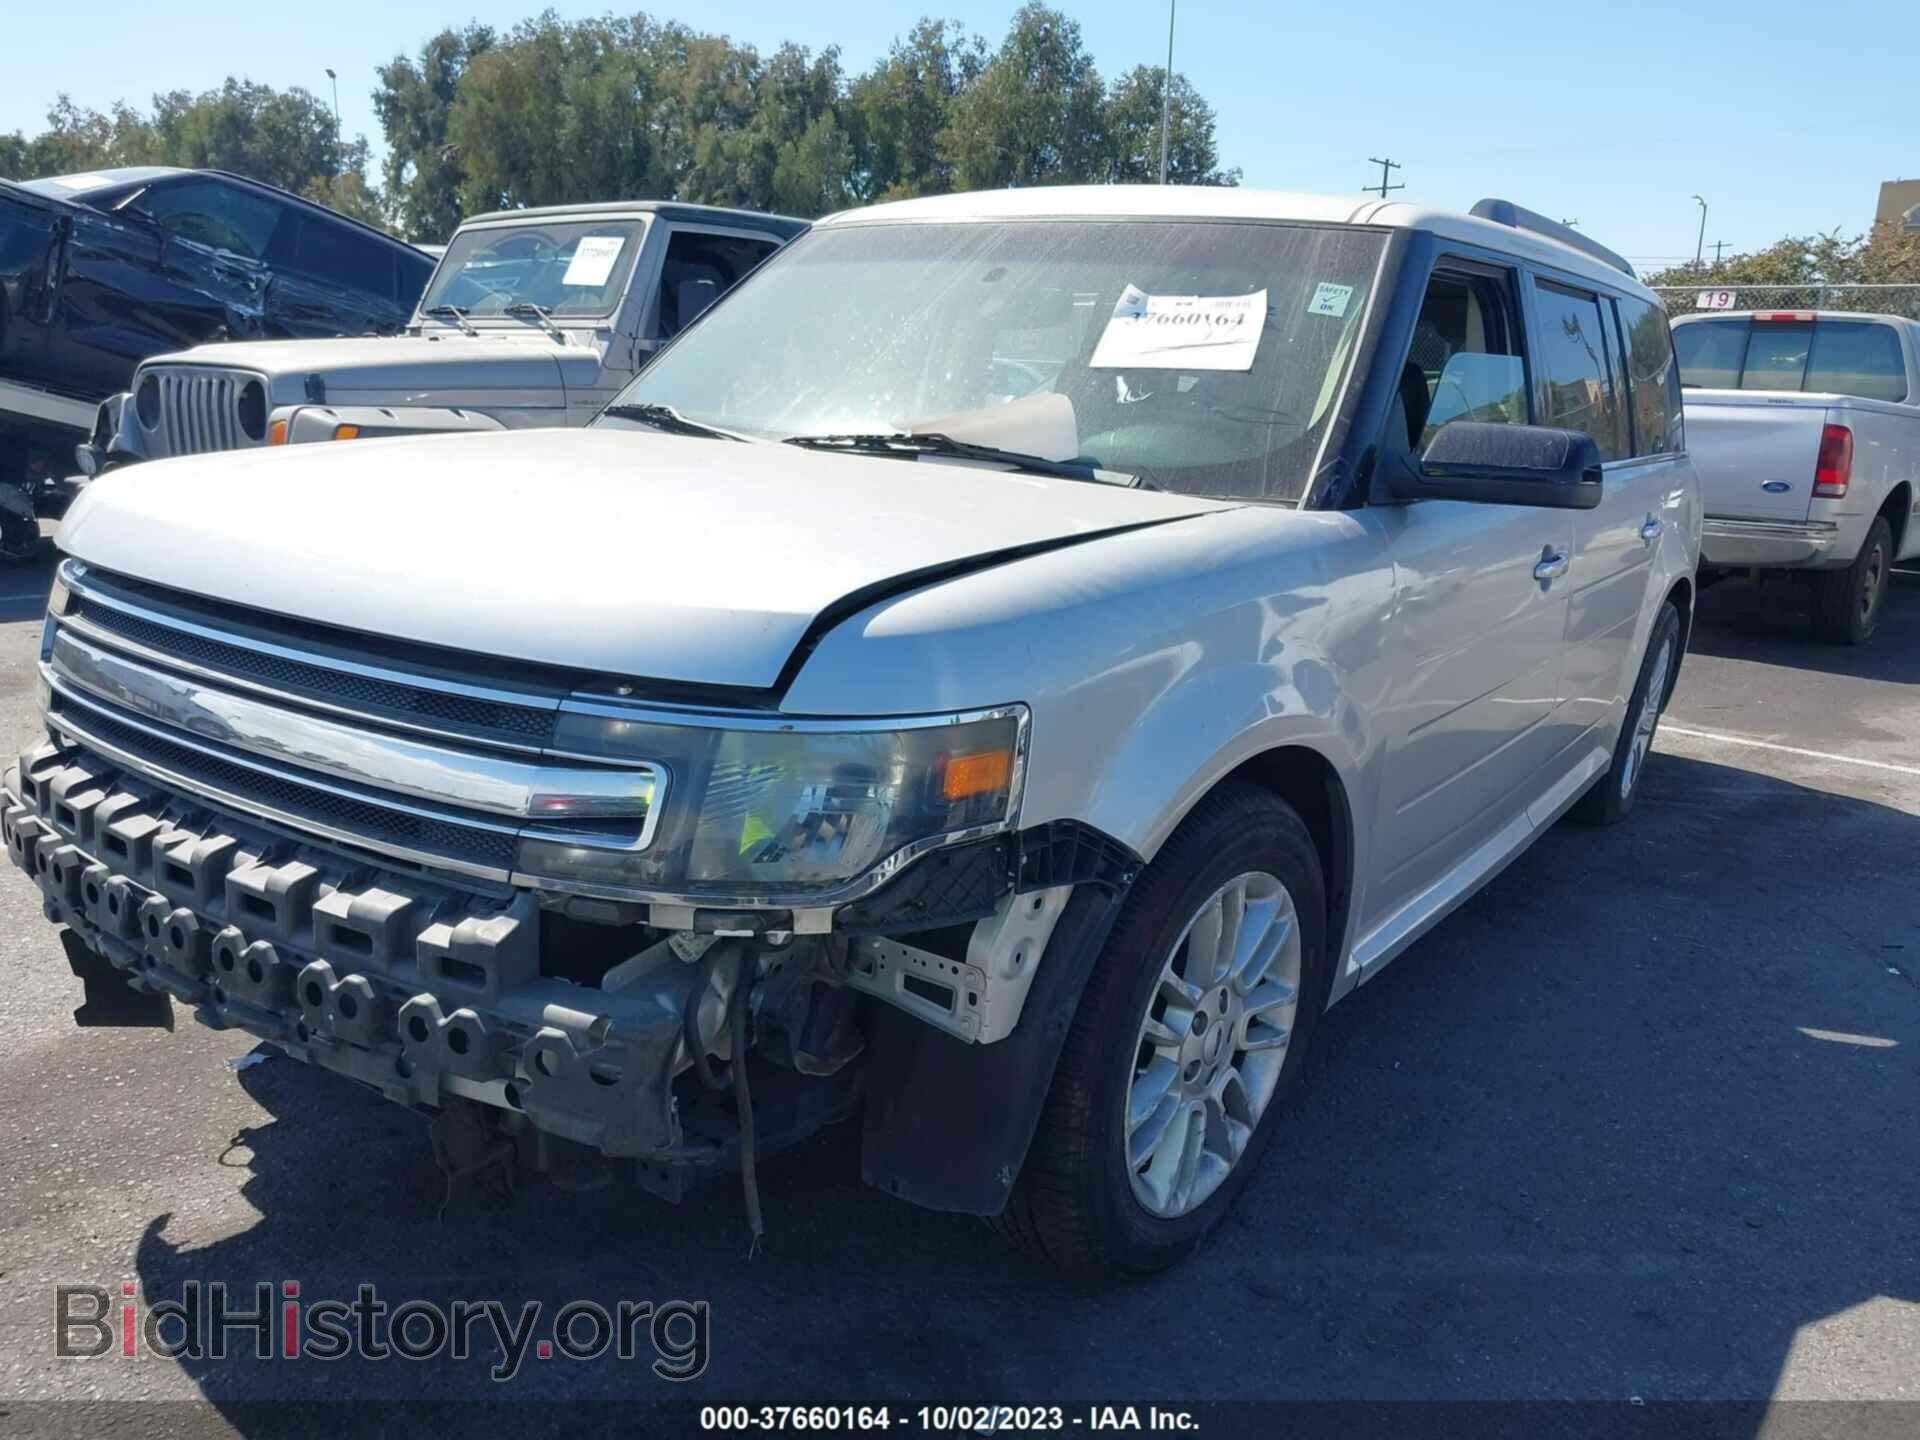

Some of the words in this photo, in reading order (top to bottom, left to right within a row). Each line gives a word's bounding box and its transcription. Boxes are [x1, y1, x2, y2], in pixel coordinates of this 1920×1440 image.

[1319, 285, 1350, 297] SAFETY
[1705, 291, 1729, 307] 19
[1320, 303, 1335, 313] OK
